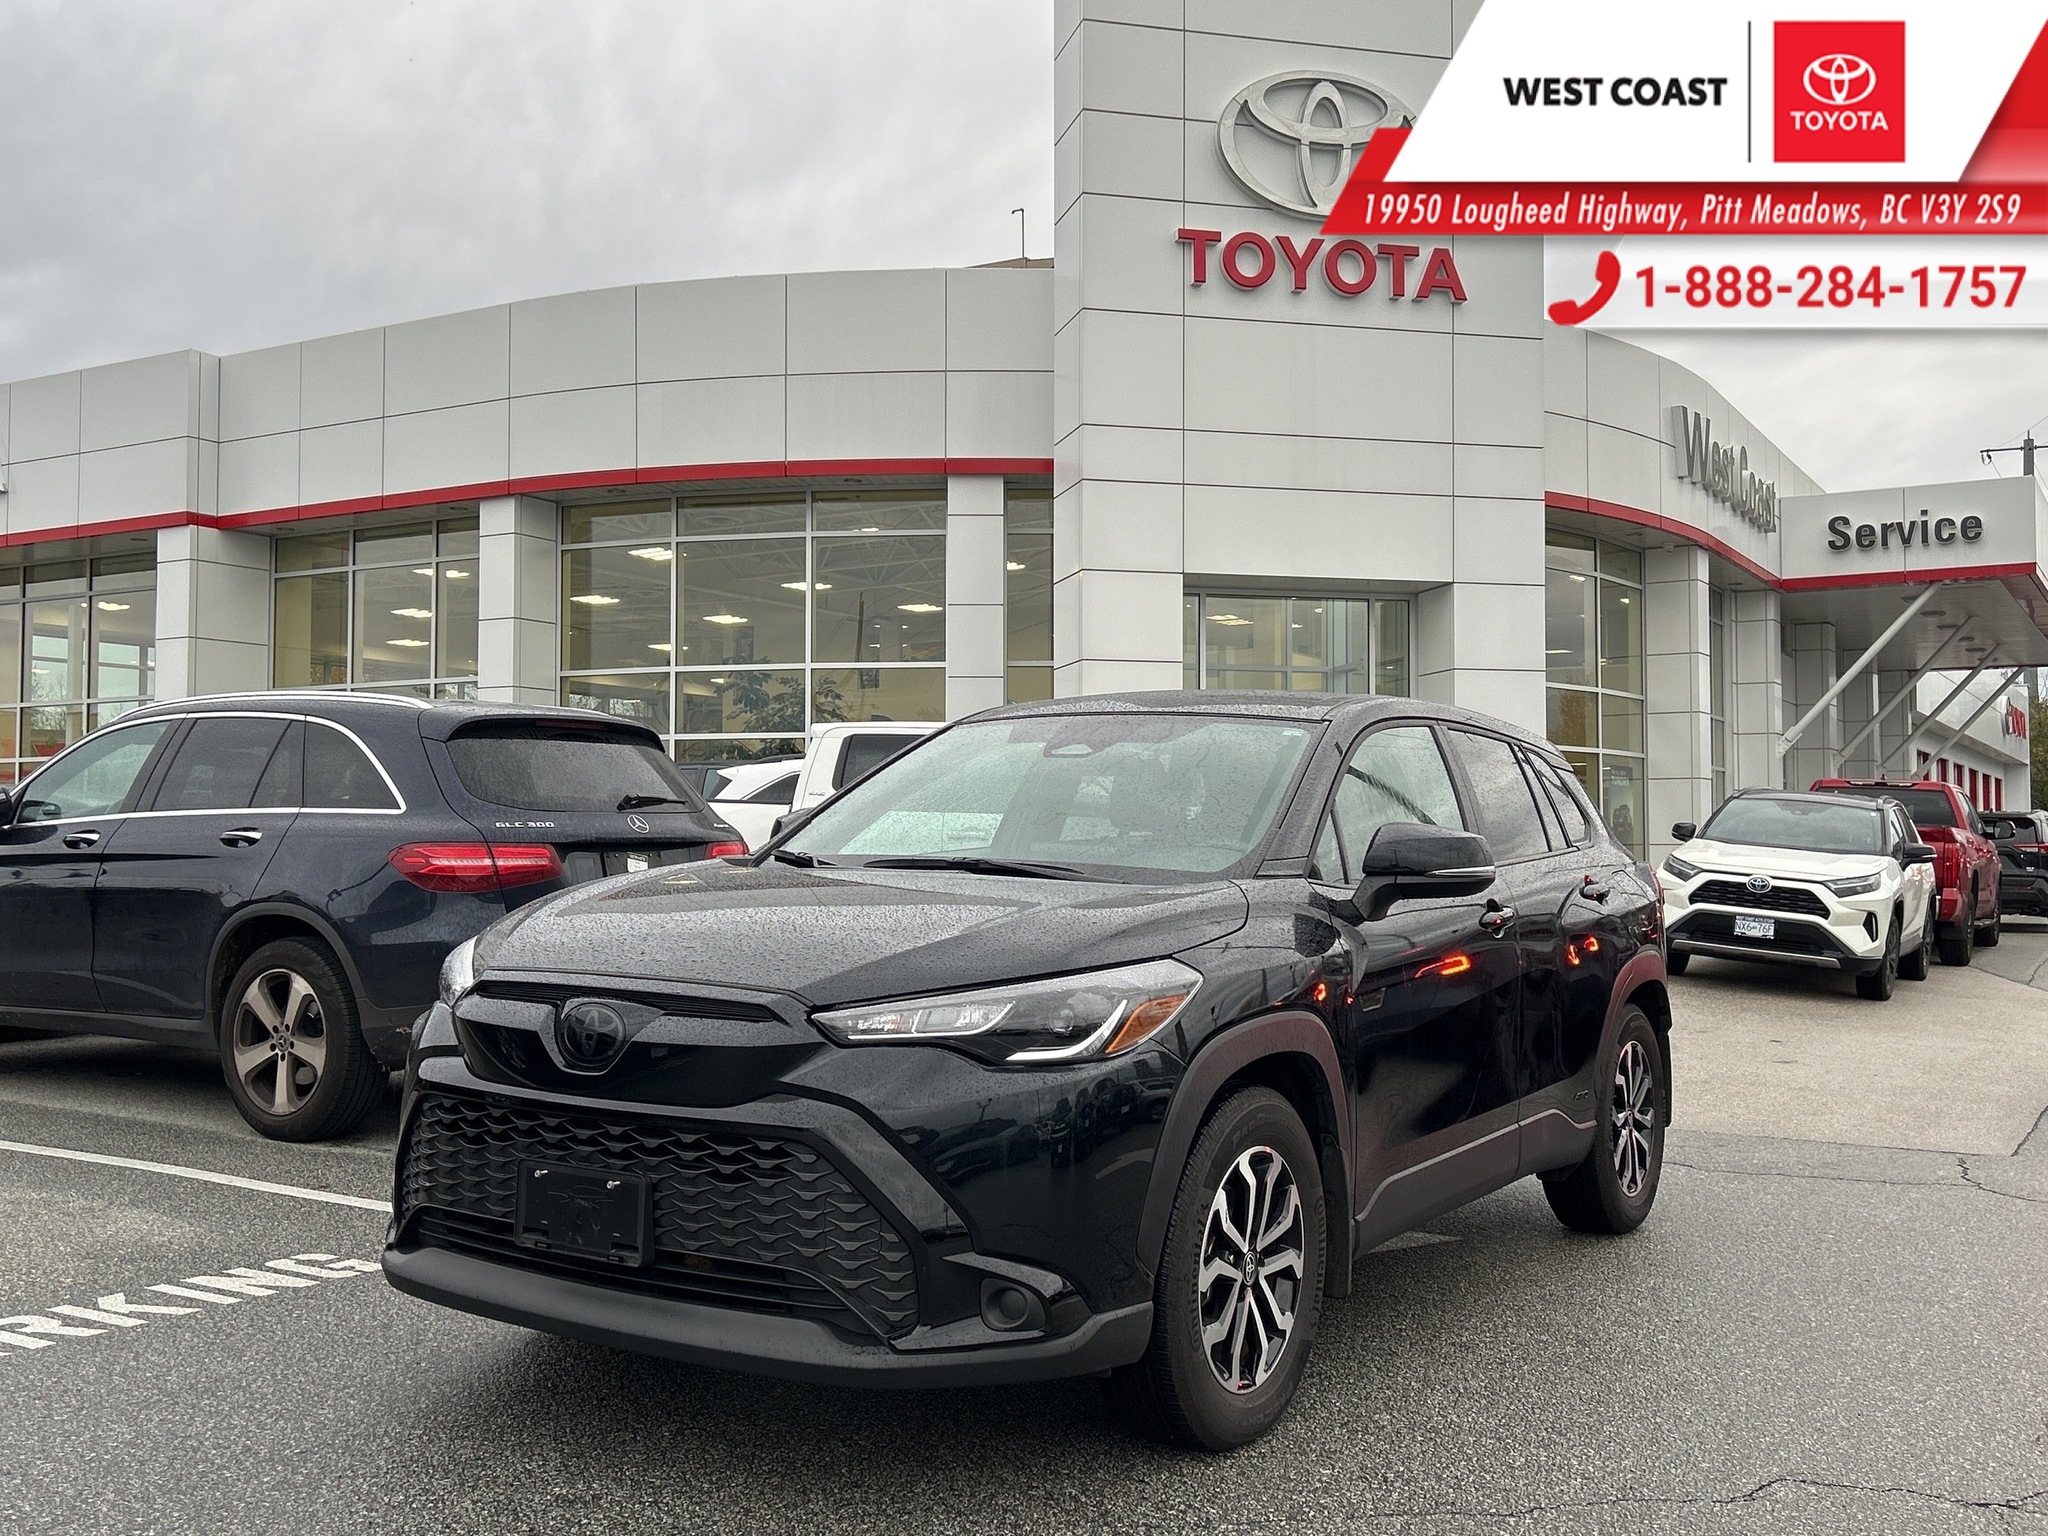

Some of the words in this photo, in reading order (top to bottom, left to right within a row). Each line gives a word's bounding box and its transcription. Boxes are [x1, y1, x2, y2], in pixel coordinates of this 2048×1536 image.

[1175, 228, 1468, 304] TOYOTA
[1673, 405, 1735, 508] West
[1735, 445, 1776, 532] Coast
[1827, 508, 1983, 551] Service
[0, 1254, 383, 1356] RKING
